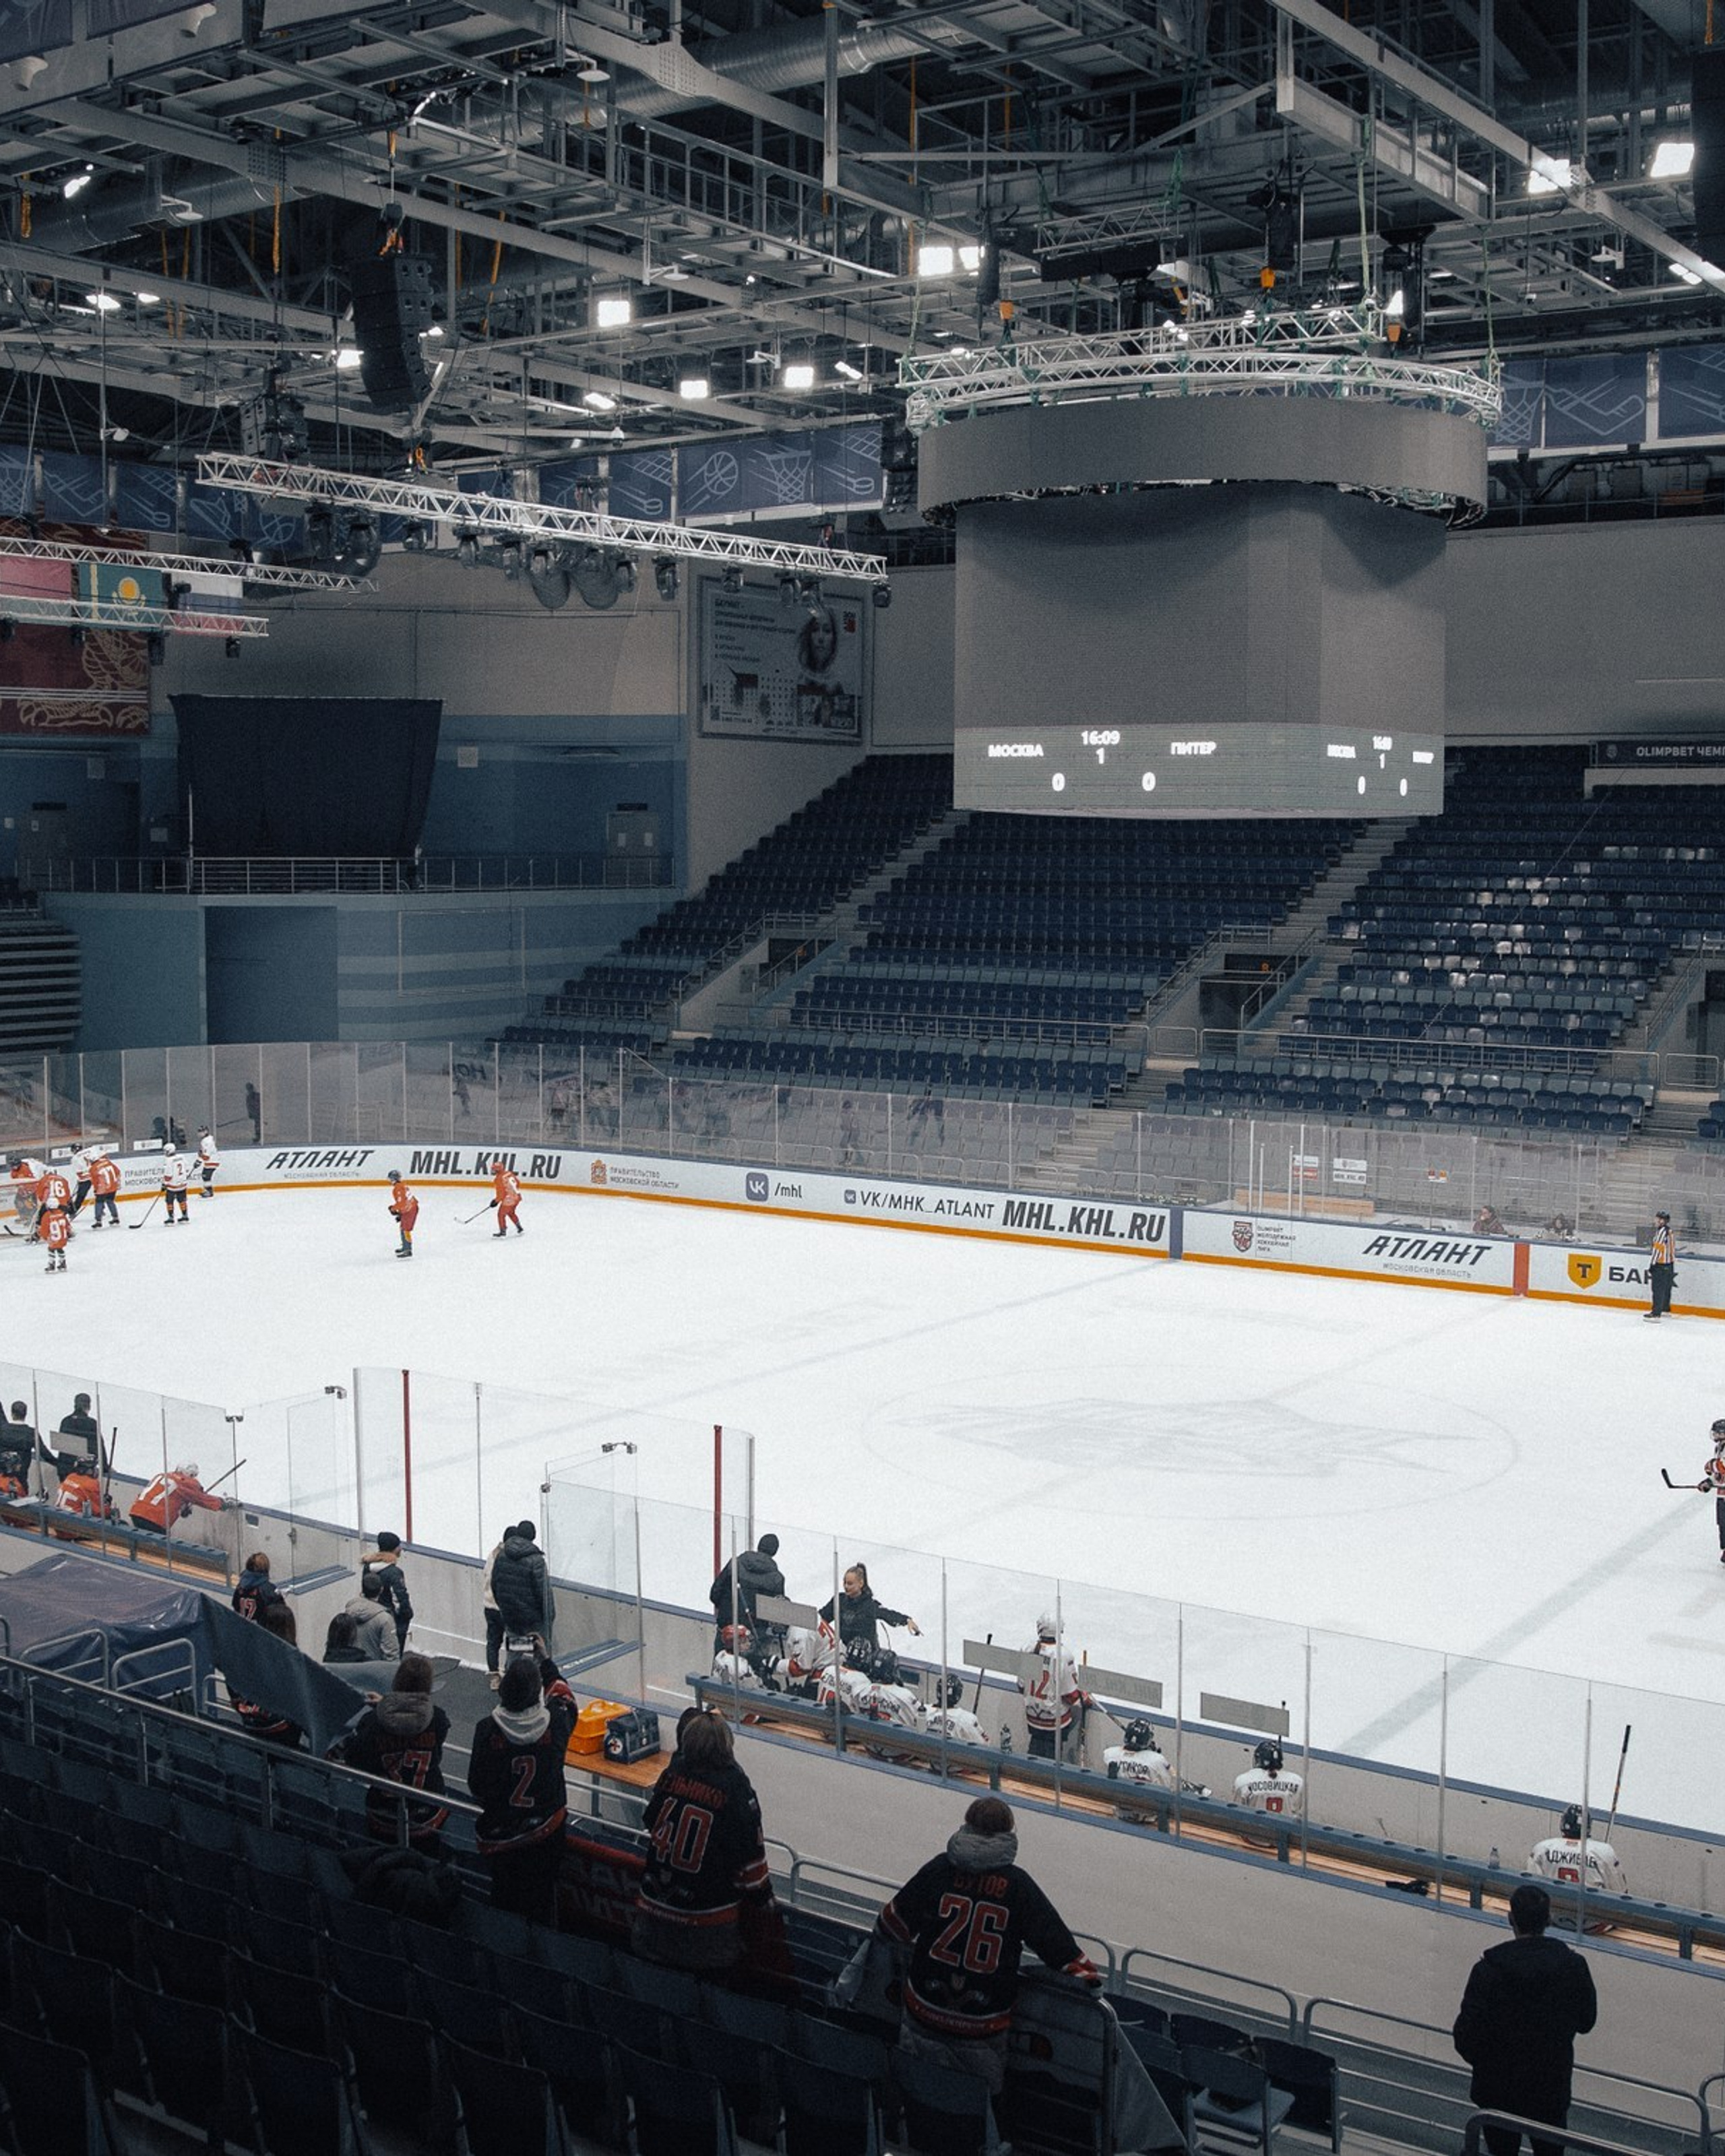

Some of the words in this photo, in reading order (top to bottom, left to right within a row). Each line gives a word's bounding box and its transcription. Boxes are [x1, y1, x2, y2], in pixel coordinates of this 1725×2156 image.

[1081, 730, 1121, 745] 16:09
[988, 744, 1044, 757] МОСКВА
[1096, 747, 1105, 764] 1
[1170, 742, 1217, 755] ПИТЕР
[1636, 746, 1695, 757] OLIMPBET
[1697, 746, 1725, 757] ЧЕМ
[1052, 773, 1065, 791] 0
[1141, 771, 1156, 792] 0
[265, 1150, 374, 1169] АТЛАНТ
[860, 1191, 995, 1219] VK/MHK_ATLANT
[49, 1218, 67, 1241] 97
[1002, 1201, 1165, 1242] MHL.KHL.RU
[1362, 1236, 1492, 1265] АТЛАНТ
[509, 1754, 536, 1808] 2
[650, 1796, 714, 1874] 40
[929, 1893, 1009, 1973] 26
